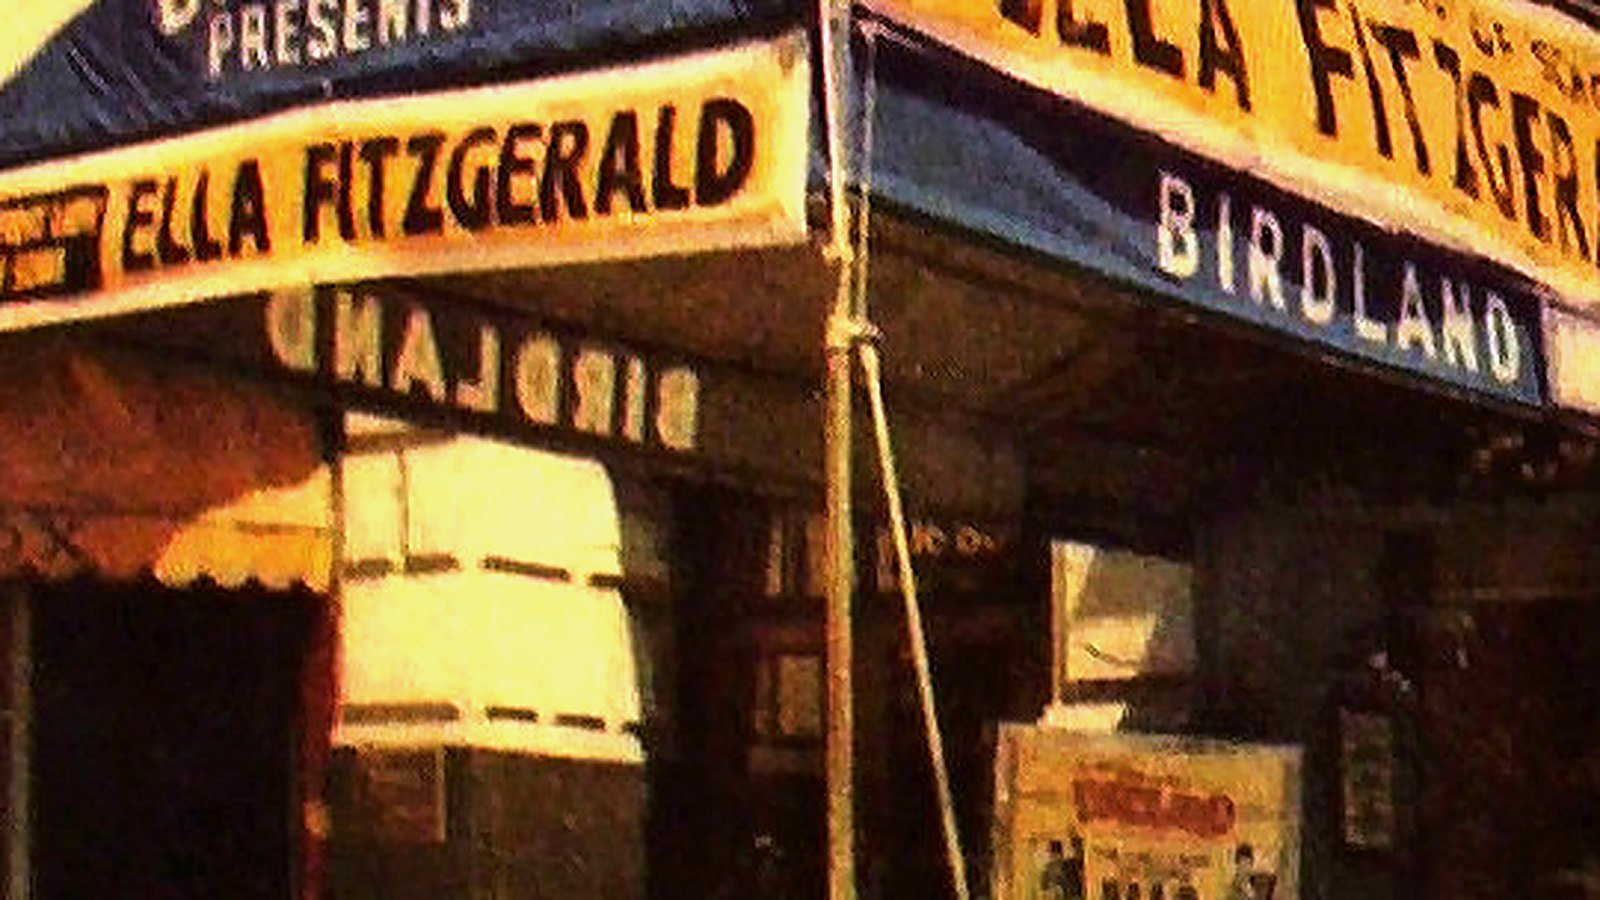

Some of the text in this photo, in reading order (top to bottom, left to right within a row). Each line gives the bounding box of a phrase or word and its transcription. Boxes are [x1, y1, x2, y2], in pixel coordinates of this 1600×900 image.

[121, 97, 755, 272] ELLA FITZGERALD
[1293, 0, 1600, 265] FITZGER
[1156, 168, 1521, 385] BIRDLAND
